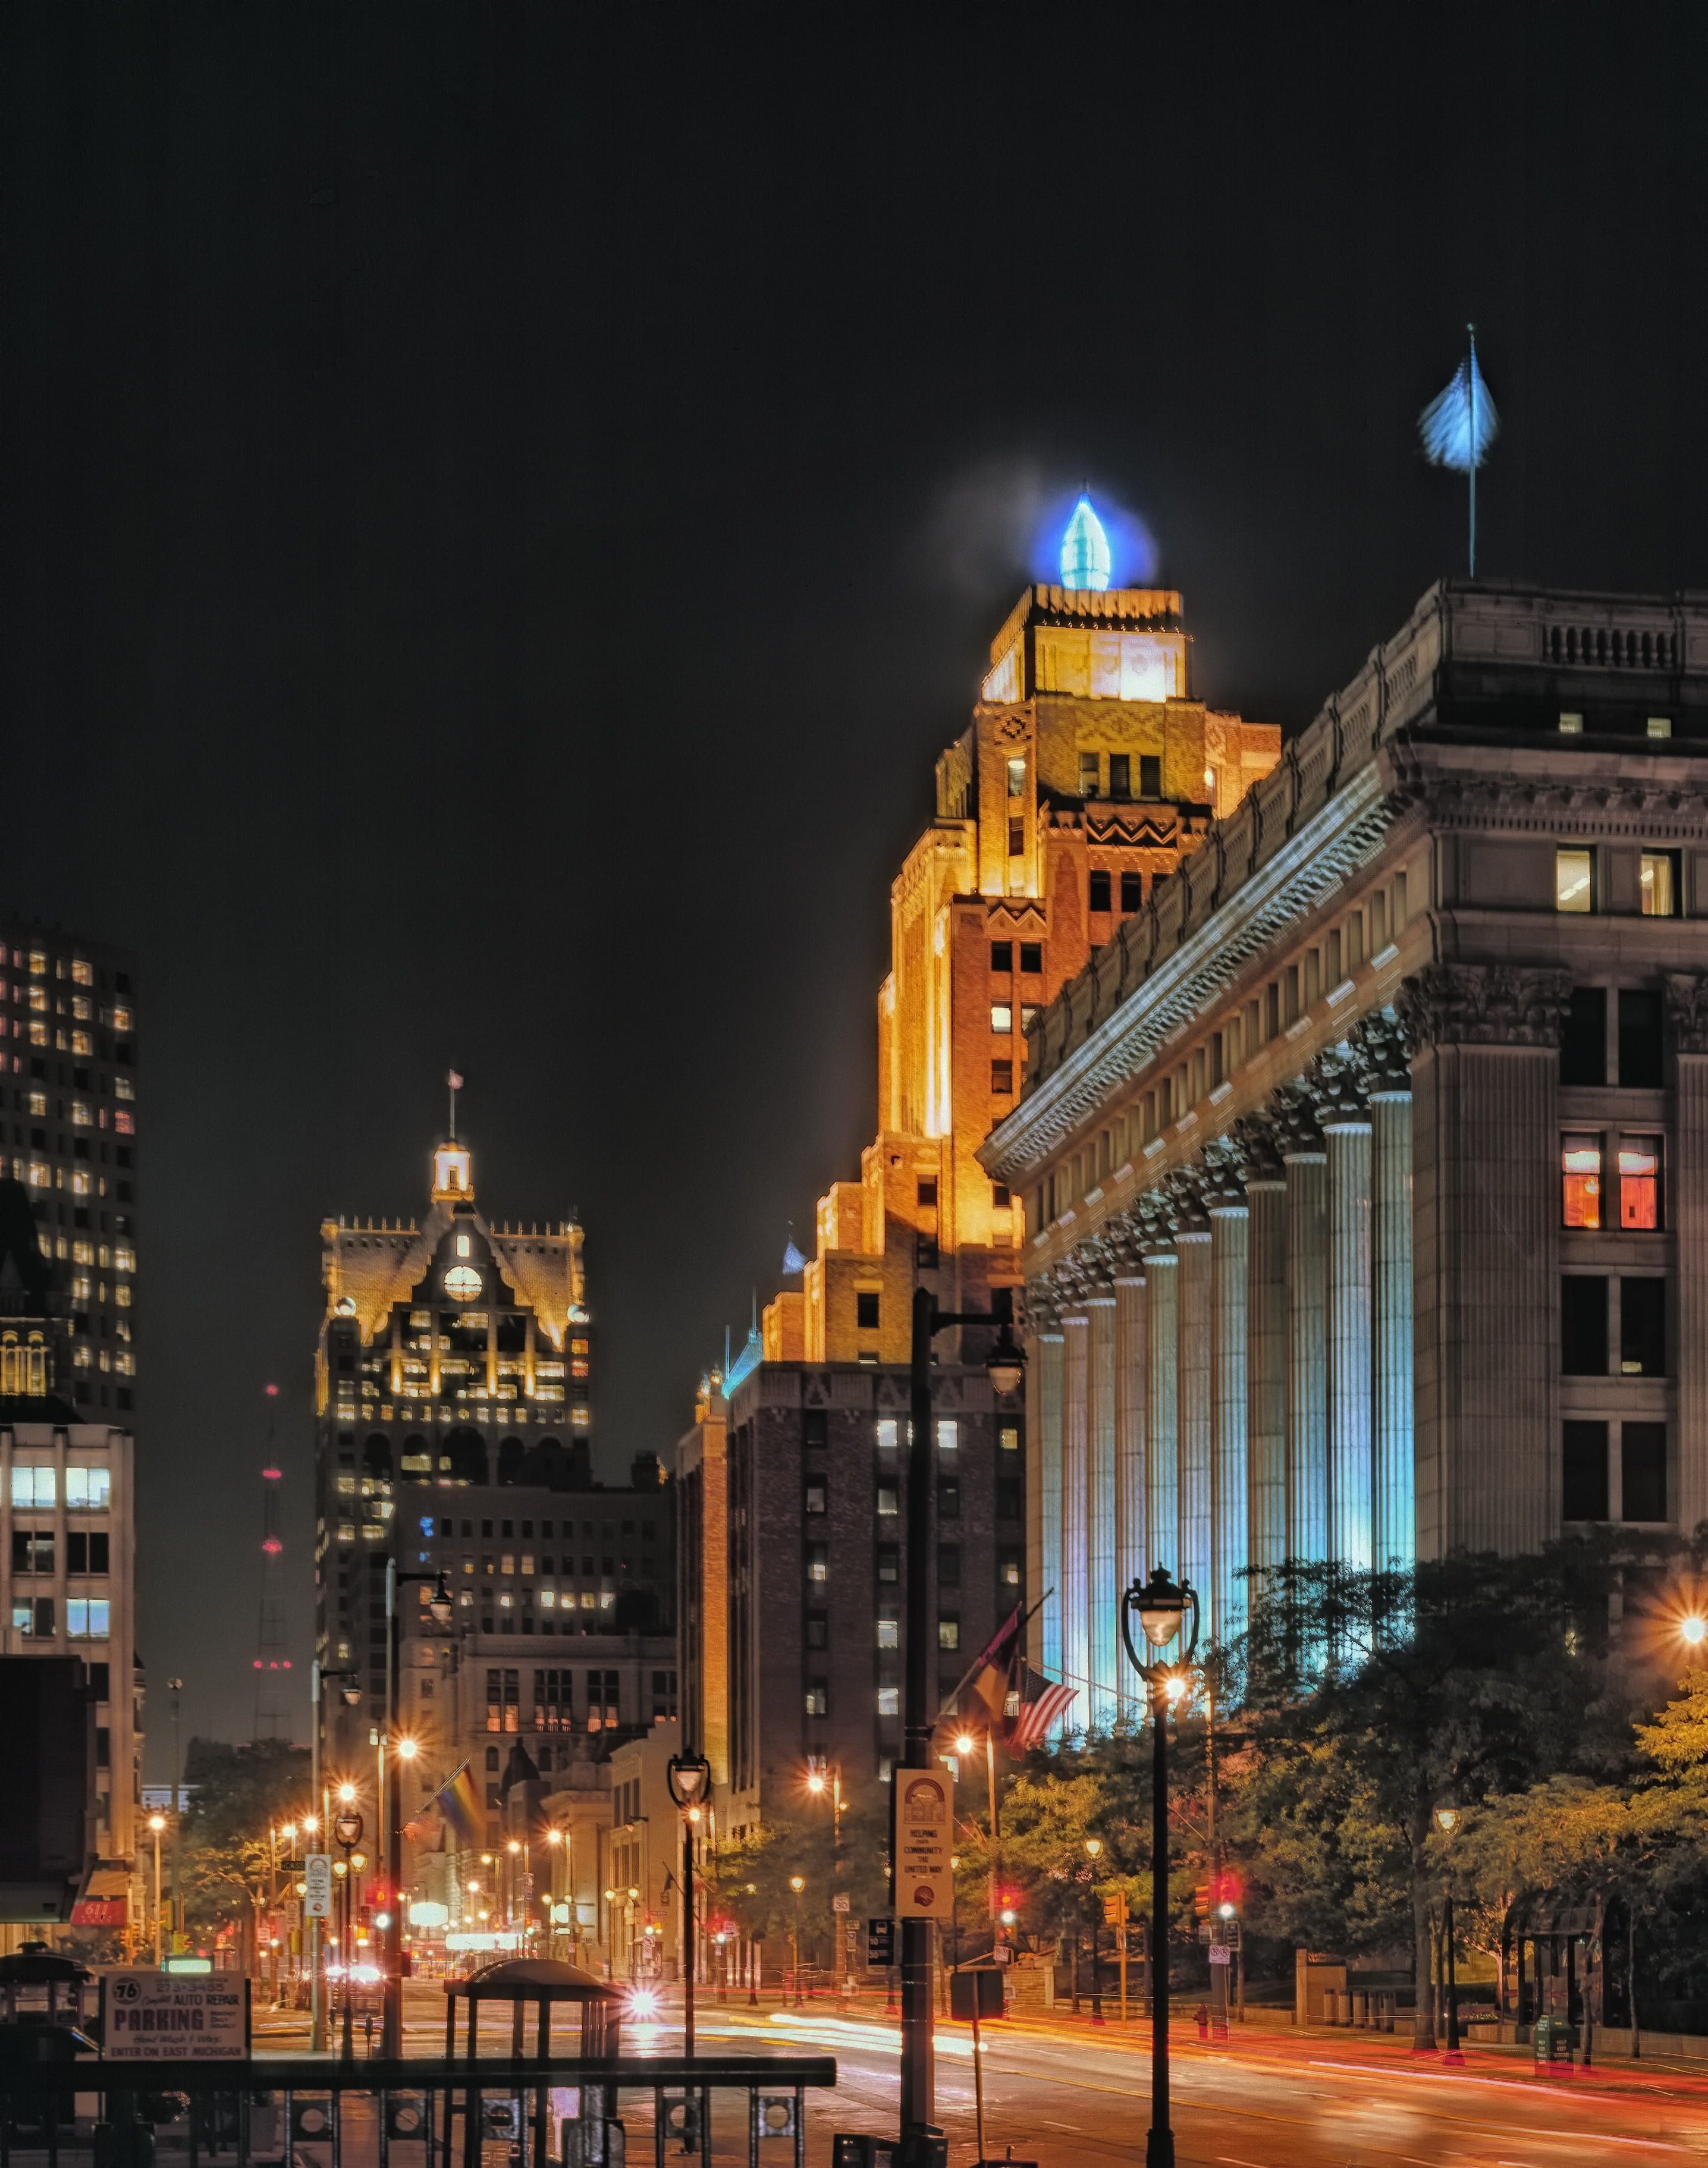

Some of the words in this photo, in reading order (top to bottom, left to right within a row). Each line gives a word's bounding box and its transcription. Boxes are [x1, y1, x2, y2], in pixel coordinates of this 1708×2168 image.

[910, 1830, 938, 1838] HELPING
[903, 1846, 943, 1854] COMMUNITY
[904, 1865, 927, 1874] UNITED
[928, 1865, 943, 1874] WAY
[85, 1904, 108, 1915] 611
[117, 1983, 137, 1999] 76
[174, 1994, 202, 2006] AUTO
[206, 1994, 240, 2006] REPAIR
[114, 2009, 205, 2031] PARKING
[111, 2047, 141, 2057] ENTER
[144, 2047, 159, 2057] ON
[163, 2047, 188, 2057] EAST
[192, 2047, 241, 2056] MICHIGAN
